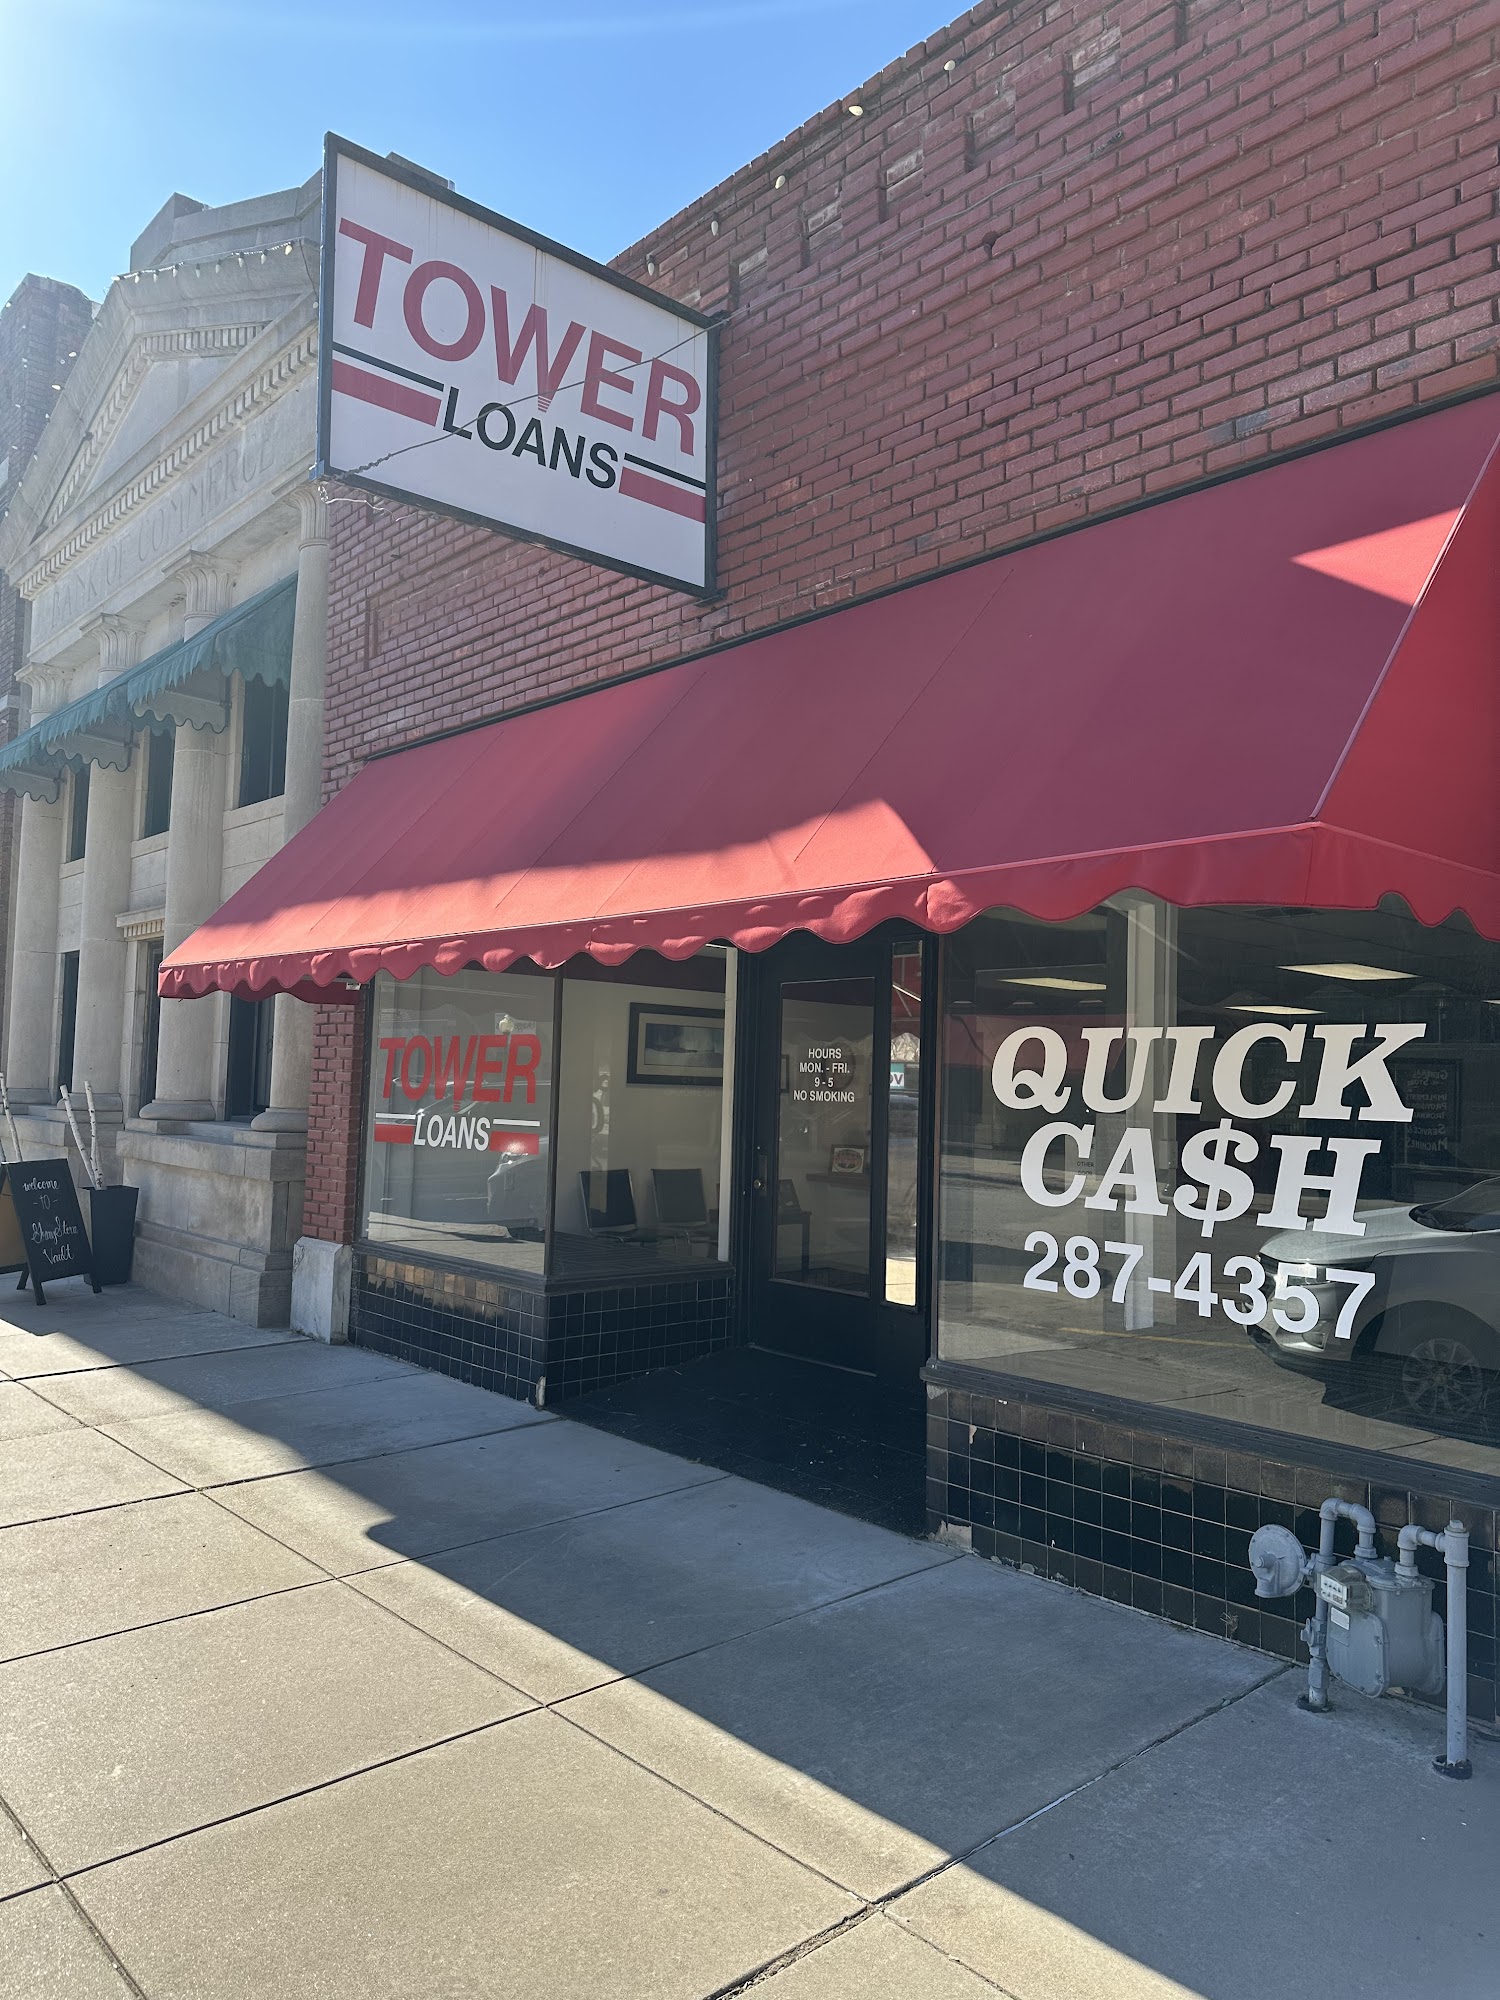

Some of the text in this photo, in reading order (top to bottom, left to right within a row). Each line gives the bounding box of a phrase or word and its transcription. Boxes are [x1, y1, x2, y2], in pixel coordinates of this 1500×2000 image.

[338, 217, 702, 456] TOWER
[442, 386, 619, 490] LOANS
[51, 430, 275, 627] BANK OF COMMERCE
[379, 1034, 542, 1108] TOWER
[799, 1062, 824, 1074] MON.
[832, 1062, 850, 1074] FRI.
[808, 1048, 842, 1060] HOURS
[991, 1022, 1427, 1122] QUICK
[793, 1090, 855, 1103] NO SMOKING
[814, 1077, 821, 1088] 9
[828, 1077, 834, 1088] 5
[413, 1114, 491, 1151] LOANS
[22, 1177, 60, 1192] welcome
[1019, 1118, 1382, 1238] CA$H
[42, 1243, 75, 1265] Vault
[1022, 1230, 1376, 1340] 287-4357
